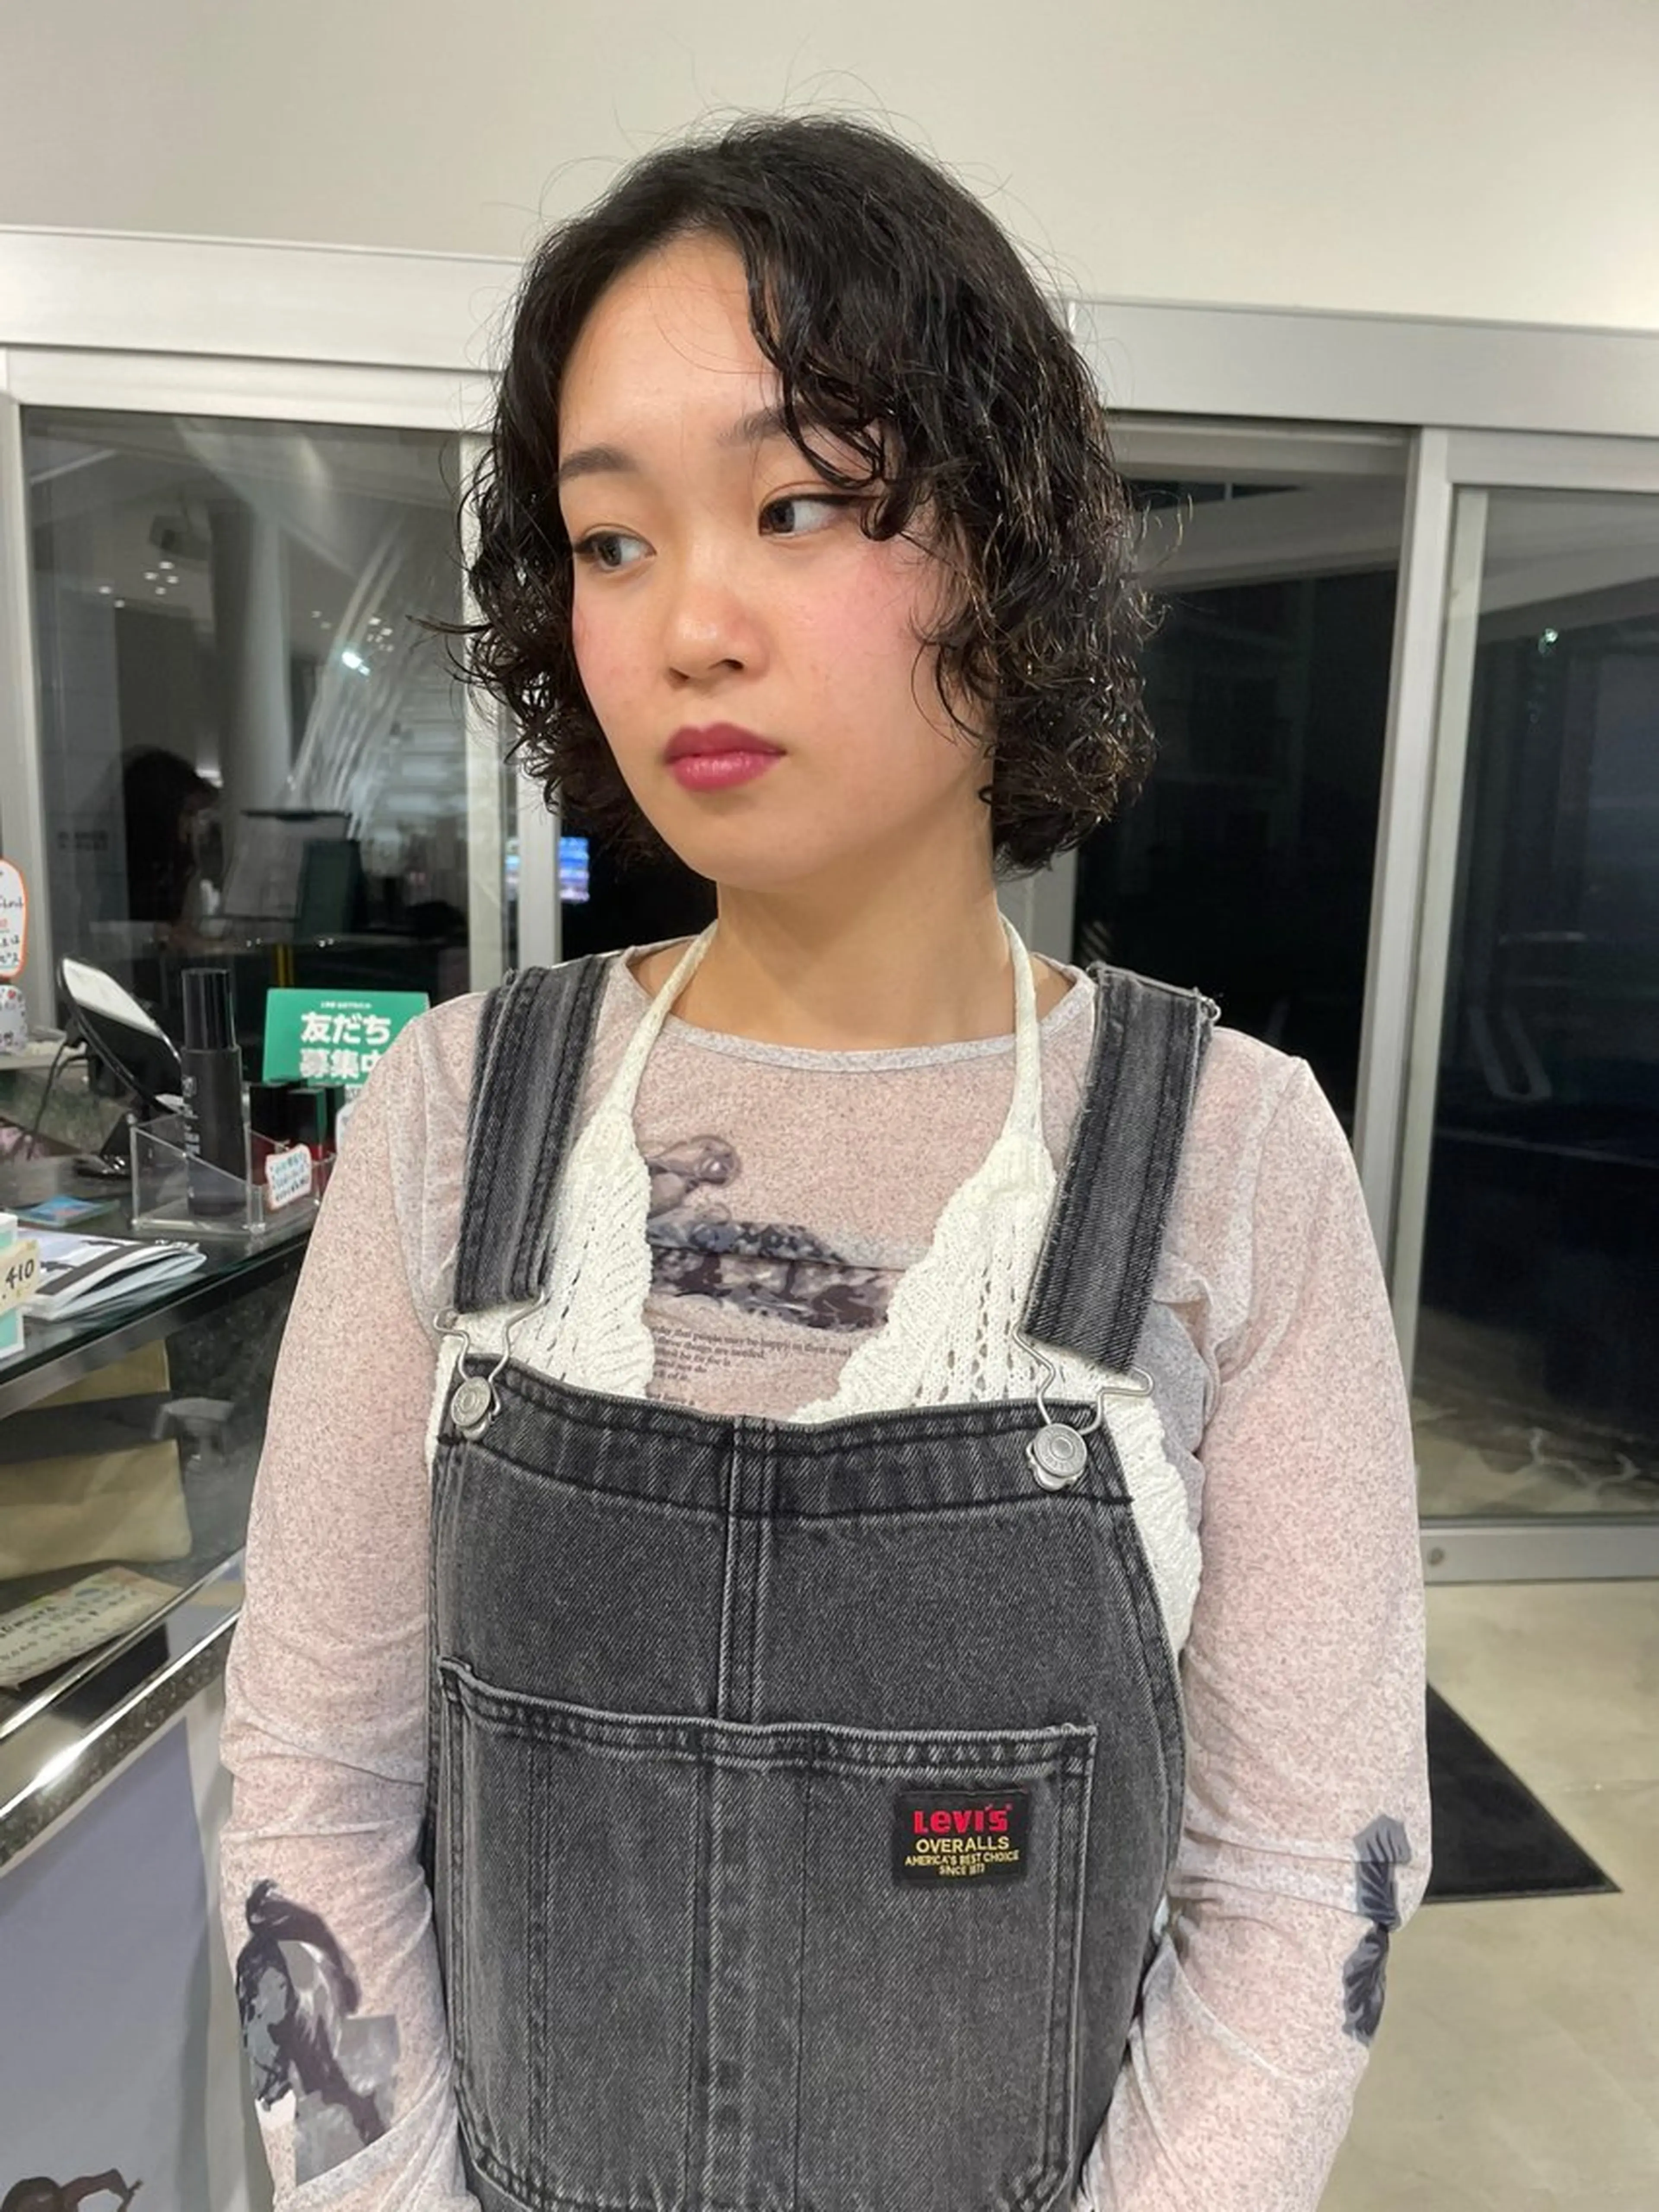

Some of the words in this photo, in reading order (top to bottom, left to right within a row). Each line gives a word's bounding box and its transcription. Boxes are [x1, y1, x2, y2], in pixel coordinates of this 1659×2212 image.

[301, 1012, 391, 1045] 友だち
[915, 1836, 1010, 1854] OVERALLS
[905, 1854, 957, 1866] AMERICA'S
[959, 1853, 982, 1866] BEST
[983, 1849, 1020, 1862] CHOICE
[938, 1865, 966, 1876] SINCE
